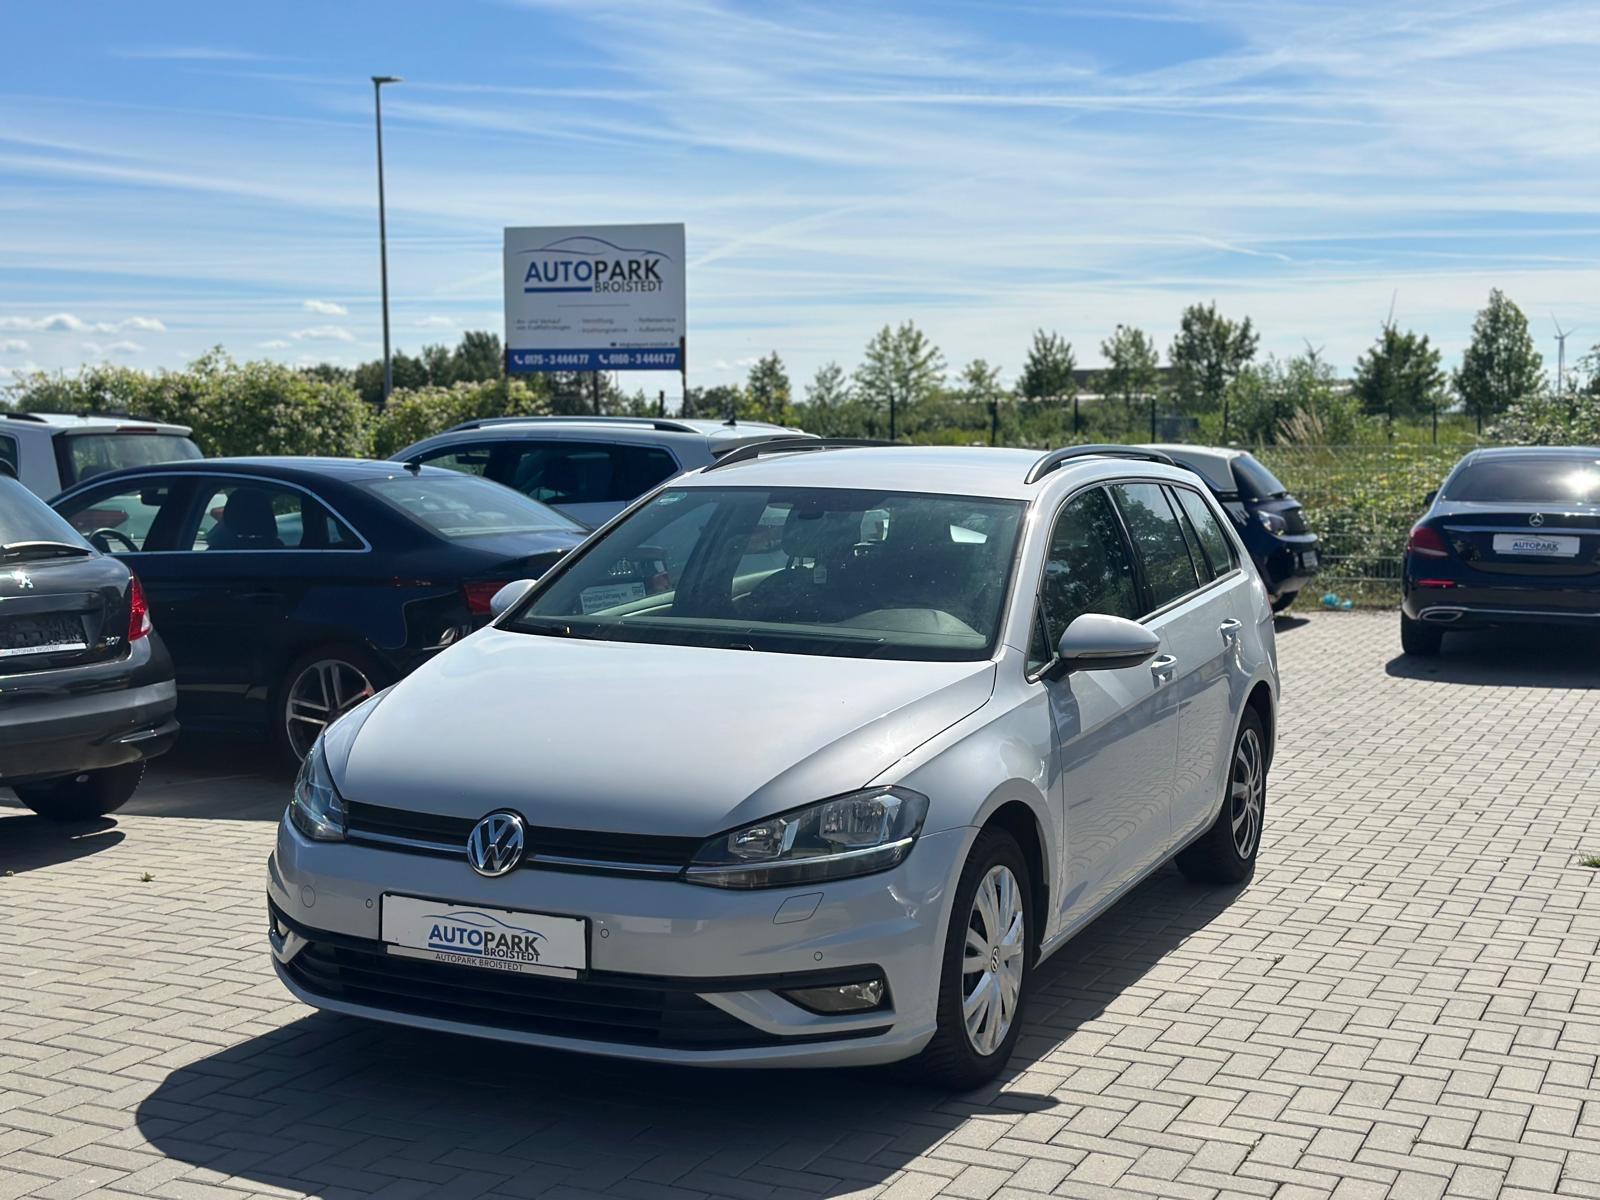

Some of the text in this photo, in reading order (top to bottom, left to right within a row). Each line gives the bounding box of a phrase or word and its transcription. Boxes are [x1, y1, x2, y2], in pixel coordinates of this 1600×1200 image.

[524, 258, 662, 283] AUTOPARK
[594, 279, 664, 294] BROISTEDT
[106, 636, 121, 646] 207
[428, 924, 541, 956] AUTOPARK
[435, 952, 524, 972] AUTOPARK BROISTEDT
[483, 947, 541, 963] BROISTEDT
